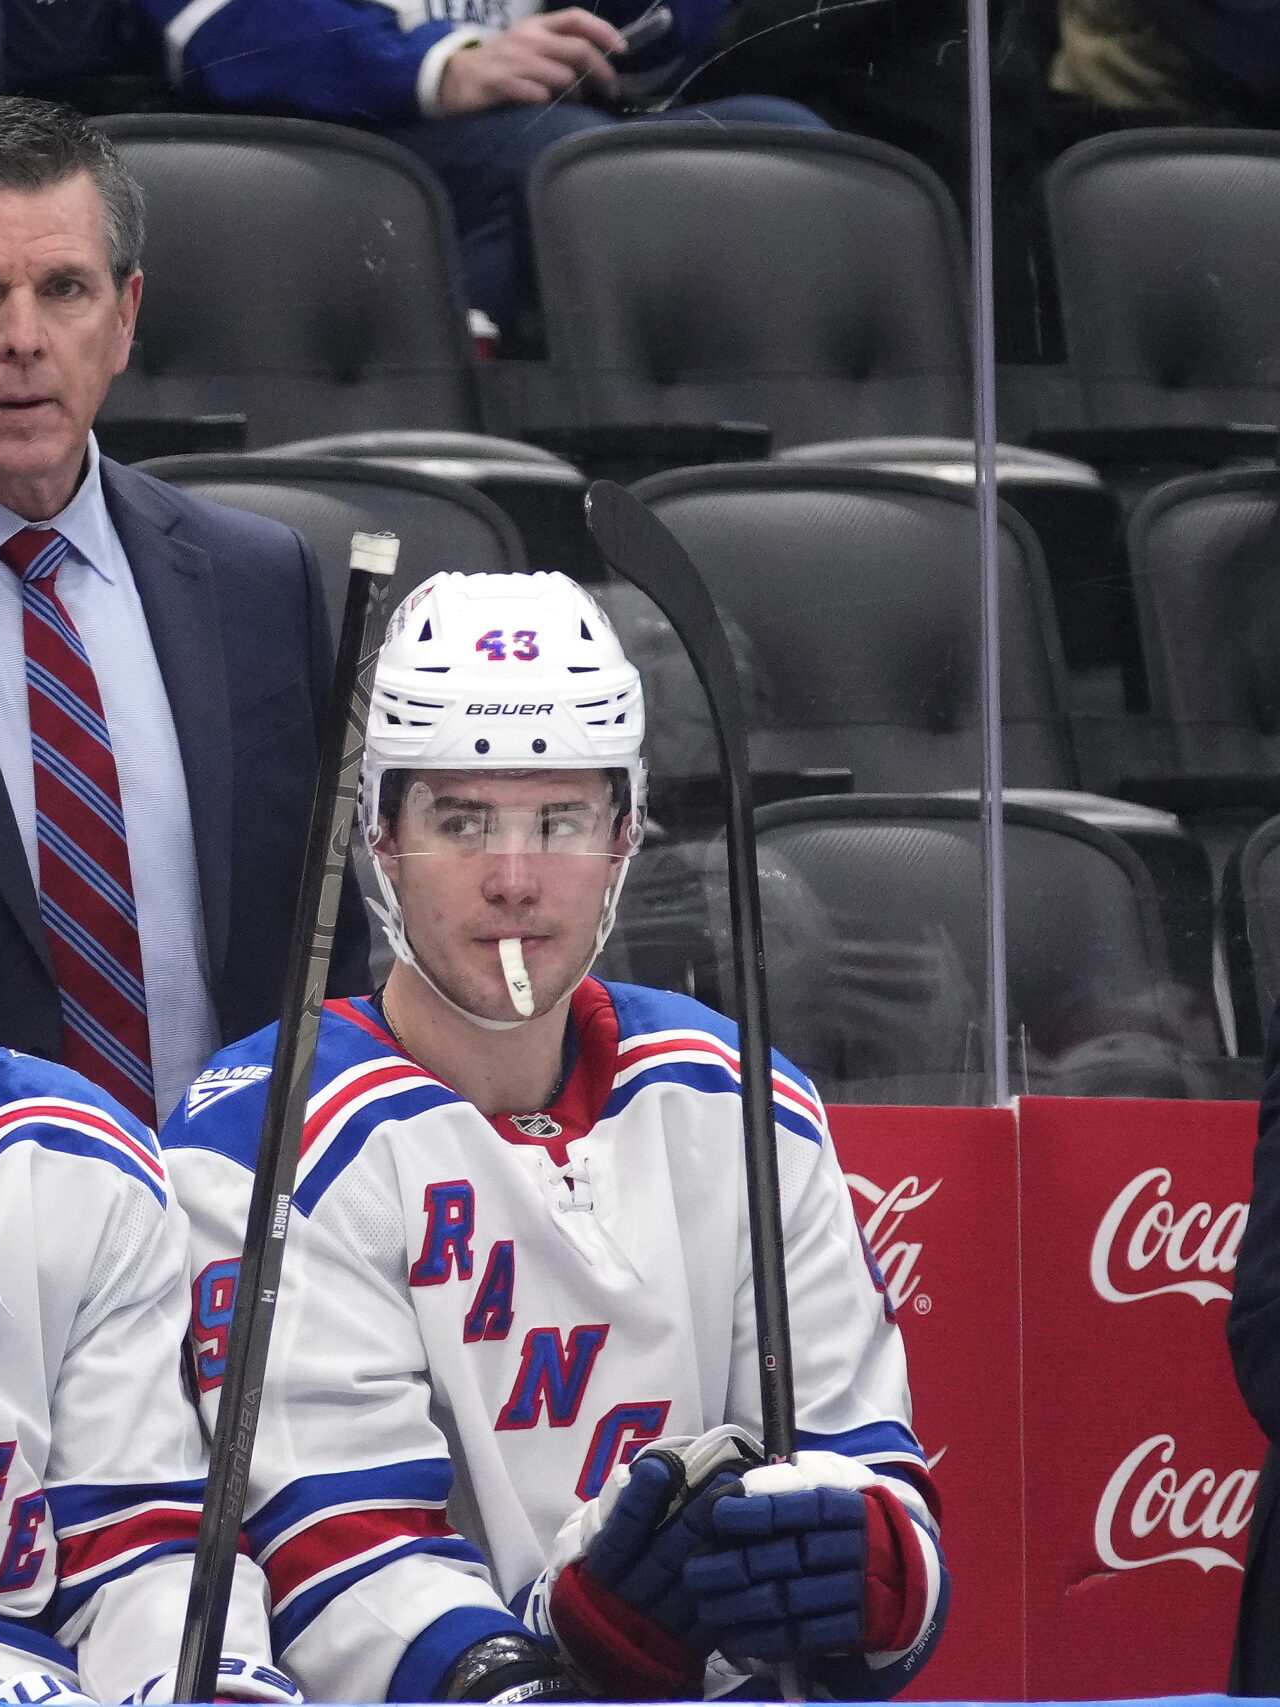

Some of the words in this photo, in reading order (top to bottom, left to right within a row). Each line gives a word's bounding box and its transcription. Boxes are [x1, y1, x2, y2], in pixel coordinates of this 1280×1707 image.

[465, 703, 554, 716] BAUER
[193, 1066, 272, 1084] GAME
[271, 1193, 291, 1240] BORGEN
[1090, 1167, 1250, 1306] Coca
[1094, 1434, 1260, 1573] Coca
